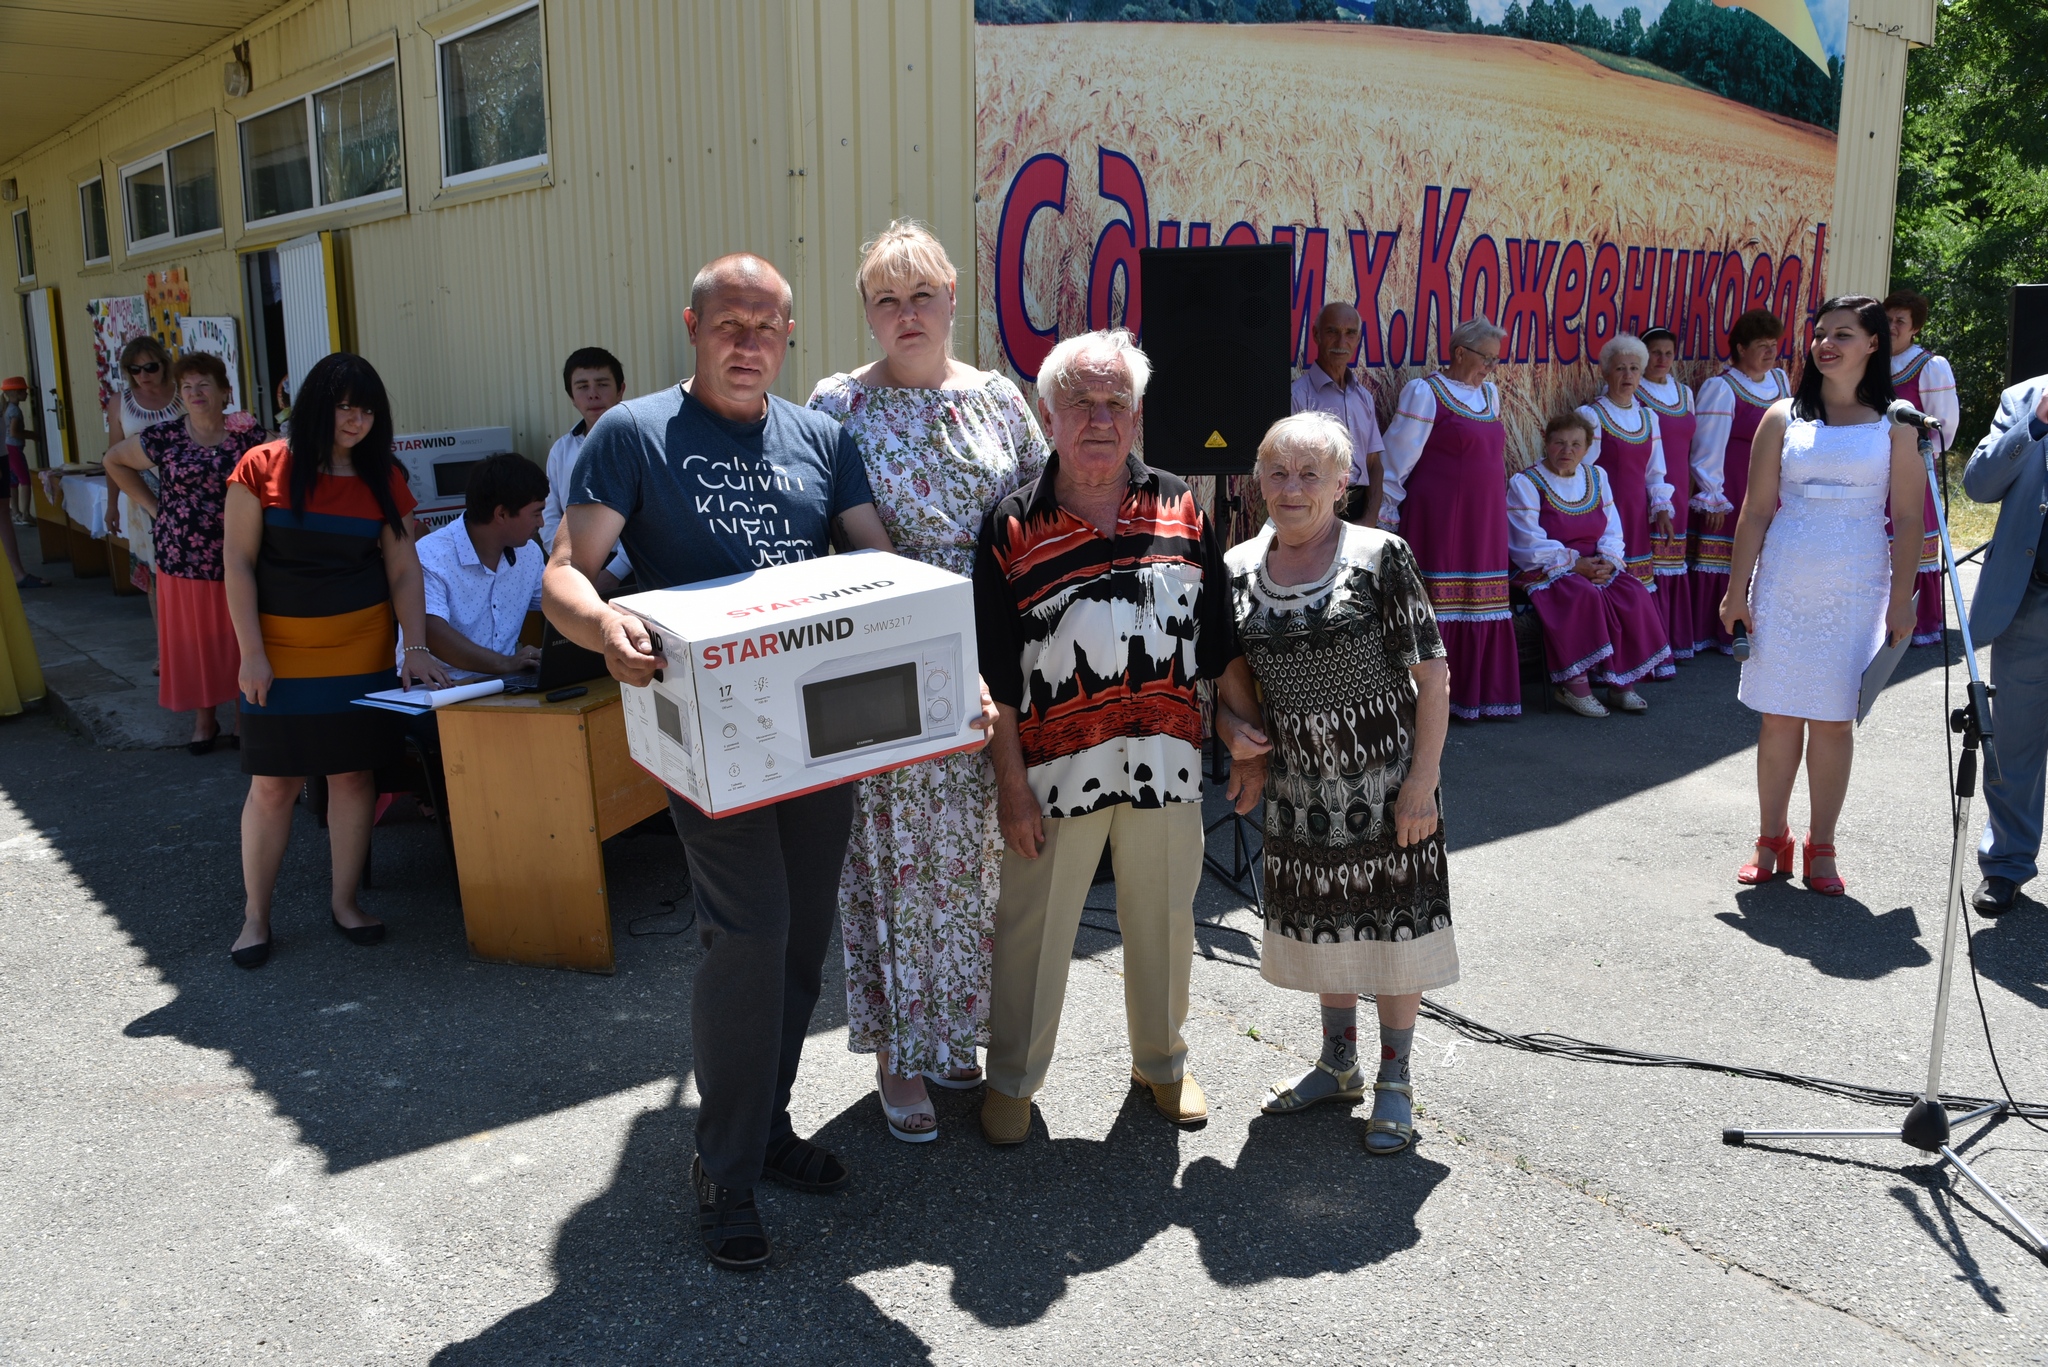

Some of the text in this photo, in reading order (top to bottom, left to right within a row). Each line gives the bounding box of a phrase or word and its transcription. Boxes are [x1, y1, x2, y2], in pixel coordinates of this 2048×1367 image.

[390, 436, 456, 452] STARWIND
[726, 580, 895, 619] STARWIND
[702, 616, 855, 671] STARWIND
[863, 615, 913, 635] SMW3217
[718, 684, 732, 698] 17
